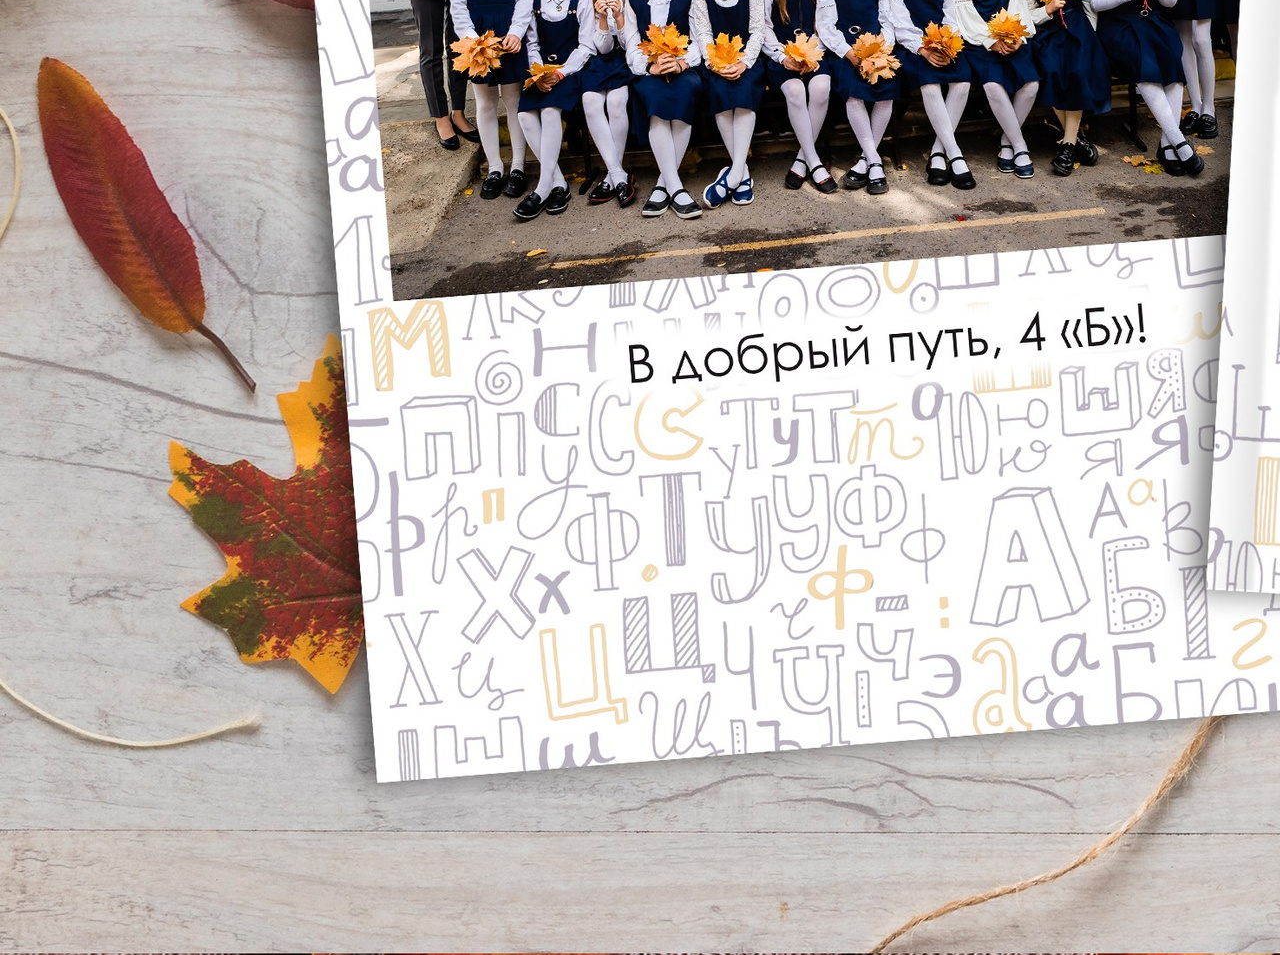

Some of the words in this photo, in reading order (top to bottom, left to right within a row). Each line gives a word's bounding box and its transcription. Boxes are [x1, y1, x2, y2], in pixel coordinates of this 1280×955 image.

[628, 343, 655, 384] В
[672, 324, 871, 383] добрый
[888, 327, 1002, 371] путь,
[1018, 310, 1047, 352] 4
[1060, 301, 1147, 349] «Б»!
